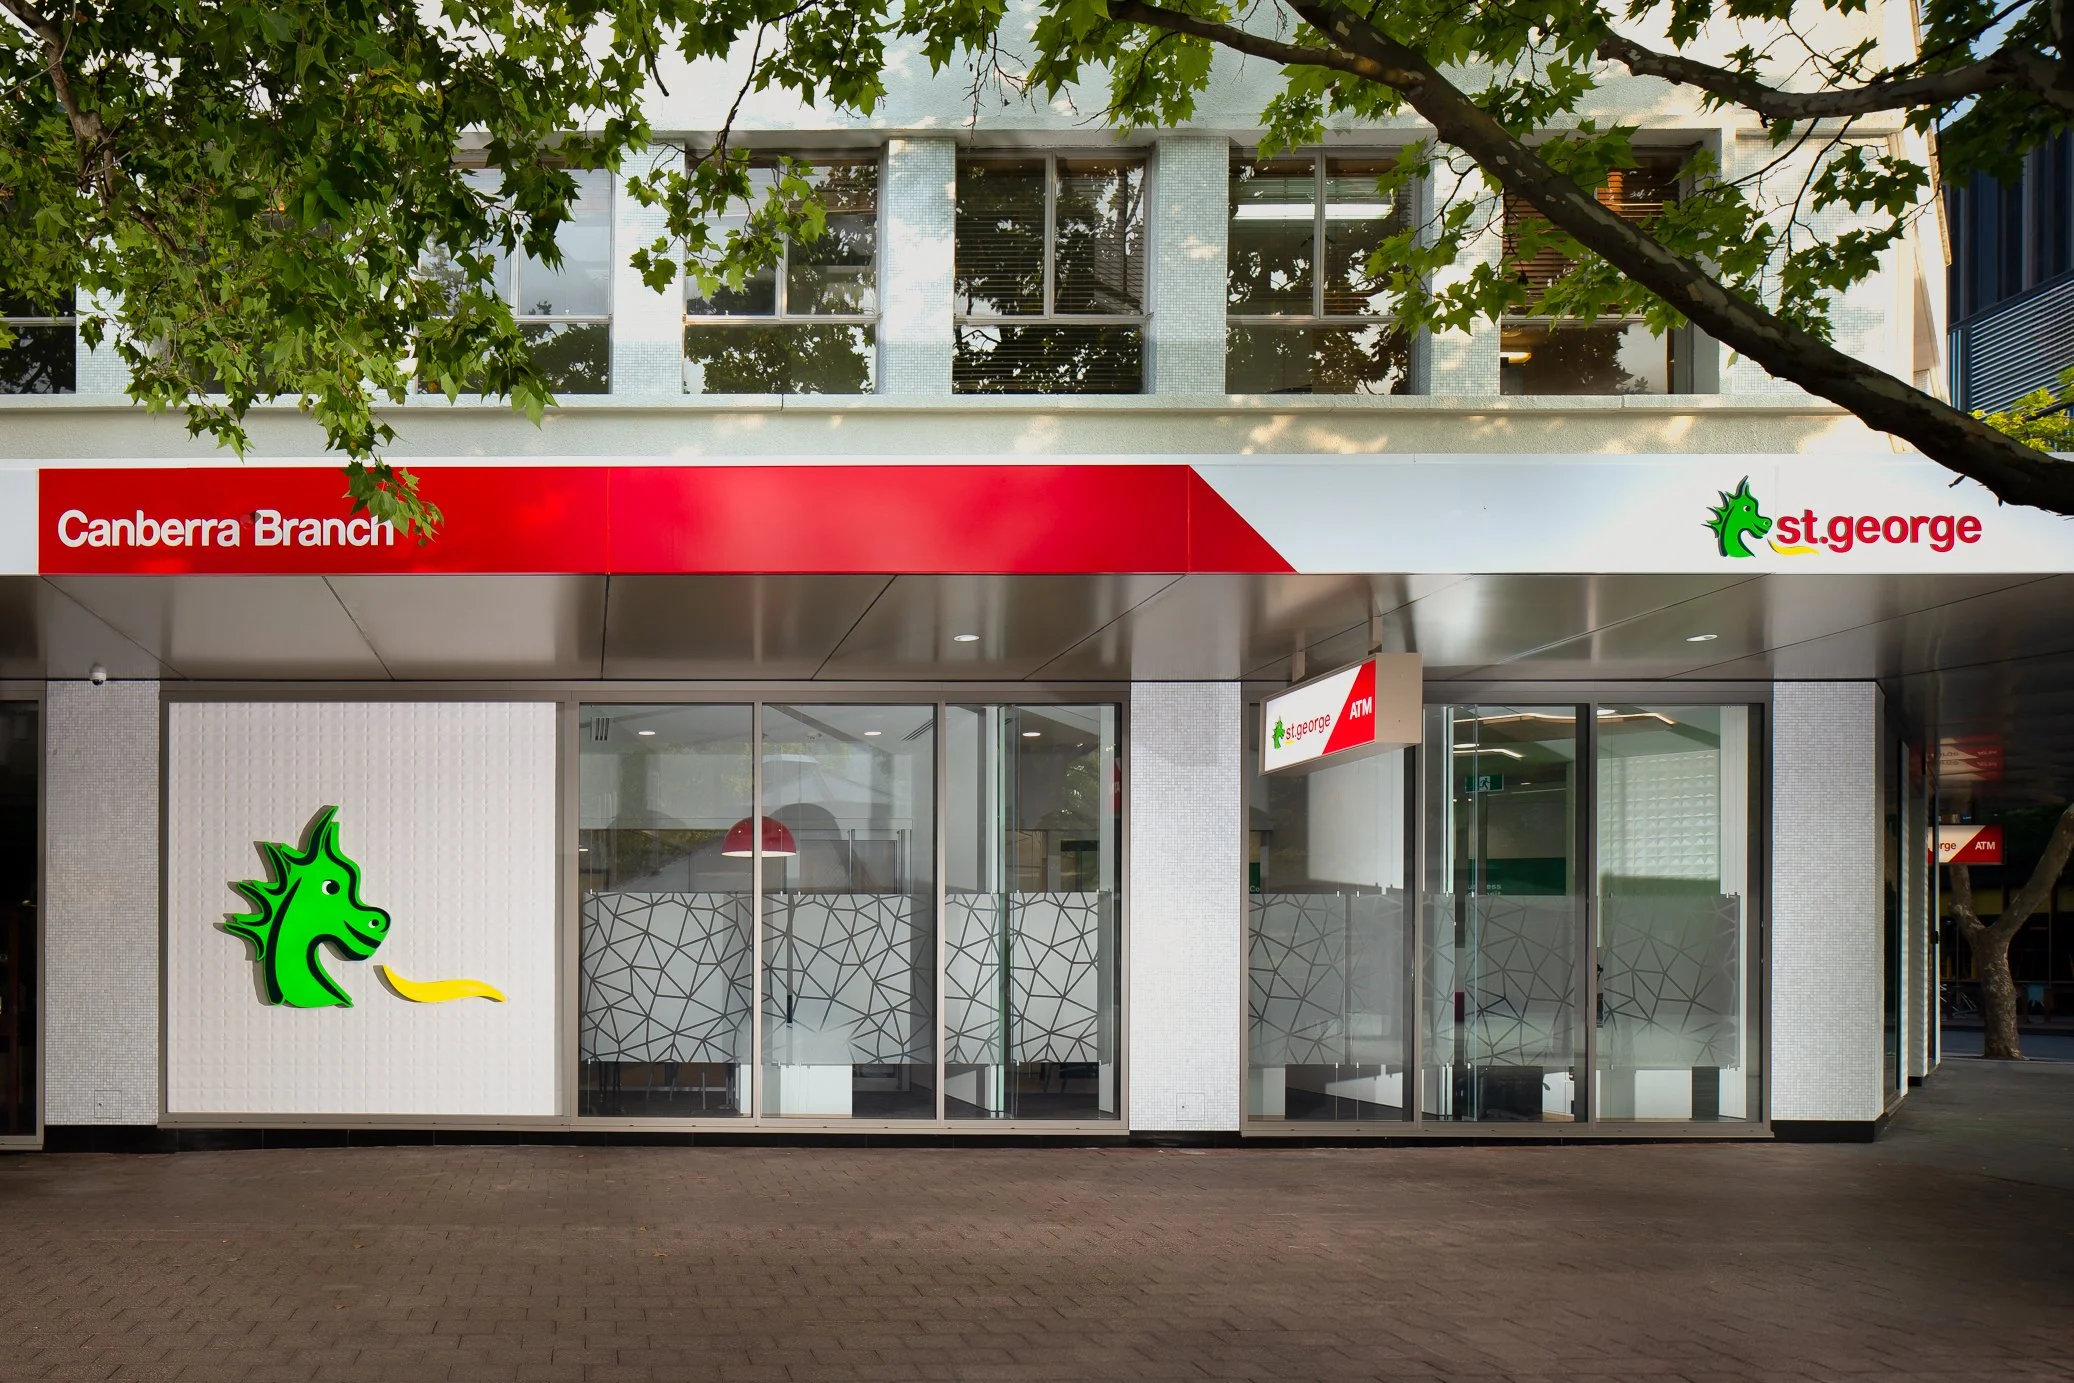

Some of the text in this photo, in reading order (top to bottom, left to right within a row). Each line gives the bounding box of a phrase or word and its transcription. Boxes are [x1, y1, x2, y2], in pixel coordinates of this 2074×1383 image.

[57, 509, 394, 548] Canberra Branch
[1776, 509, 1982, 553] st.george
[1286, 696, 1373, 740] st.george ATM
[1974, 841, 1996, 850] ATM
